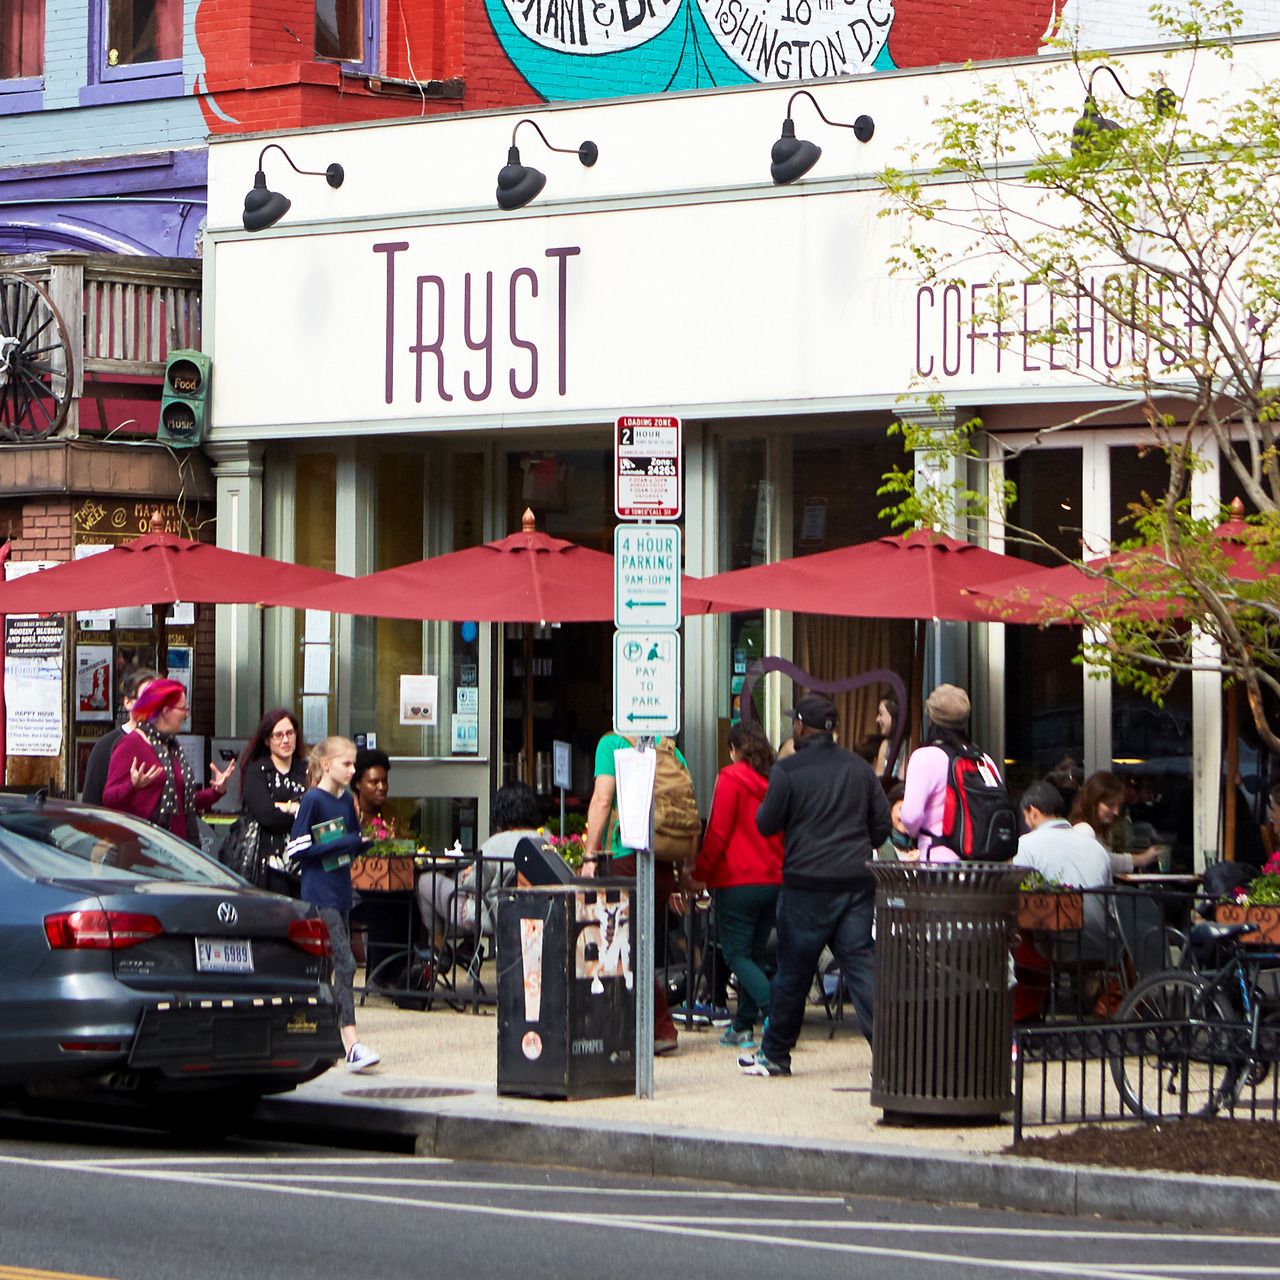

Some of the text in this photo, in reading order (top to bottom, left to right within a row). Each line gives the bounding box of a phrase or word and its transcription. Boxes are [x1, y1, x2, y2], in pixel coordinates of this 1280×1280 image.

[622, 428, 630, 445] 2
[74, 500, 95, 523] THIS
[82, 504, 108, 530] WEEK
[111, 507, 127, 528] @
[623, 537, 672, 553] 4 HOUR
[622, 555, 672, 569] PARKING
[624, 575, 671, 585] 9AM-10PM
[635, 668, 656, 677] PAY
[641, 682, 653, 691] TO
[632, 697, 661, 705] PARK
[200, 944, 248, 963] EV 6989
